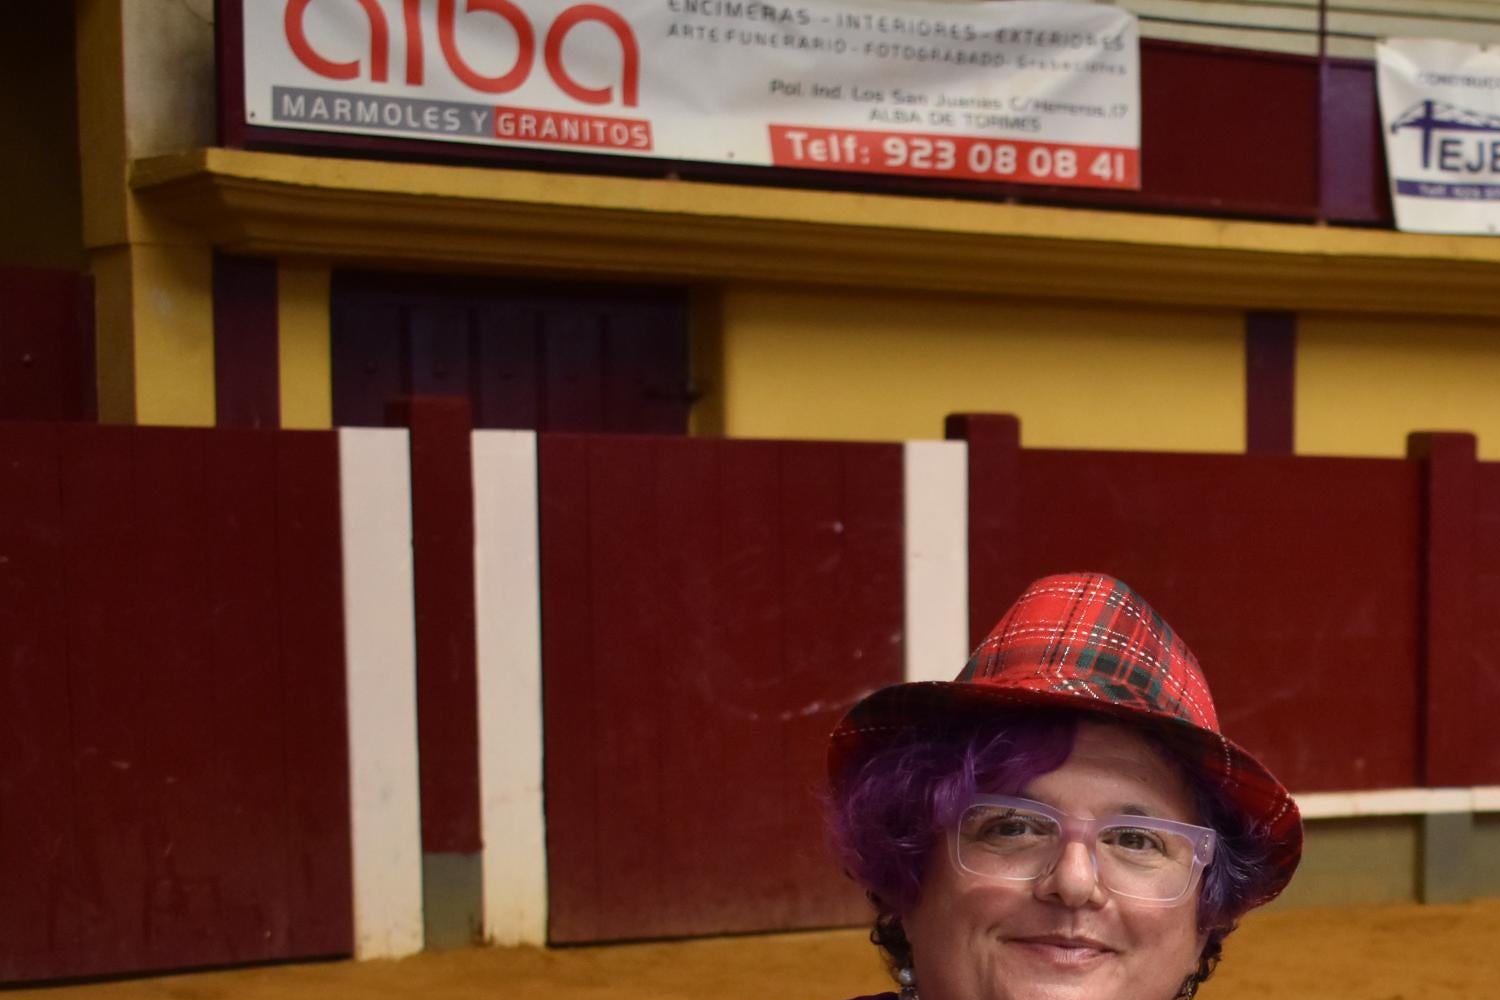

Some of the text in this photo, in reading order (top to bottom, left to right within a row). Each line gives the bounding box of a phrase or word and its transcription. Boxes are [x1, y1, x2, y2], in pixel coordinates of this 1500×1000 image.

[668, 0, 811, 26] ENCIMERAS
[836, 14, 977, 42] INTERIORES
[668, 24, 720, 43] ARTE
[724, 28, 847, 54] FUNERARIO
[284, 0, 641, 108] alba
[281, 94, 650, 148] MARMOLES Y GRANITOS
[869, 107, 922, 123] ALBA
[929, 110, 953, 126] DE
[784, 130, 1126, 182] Telf: 923 08 08 41
